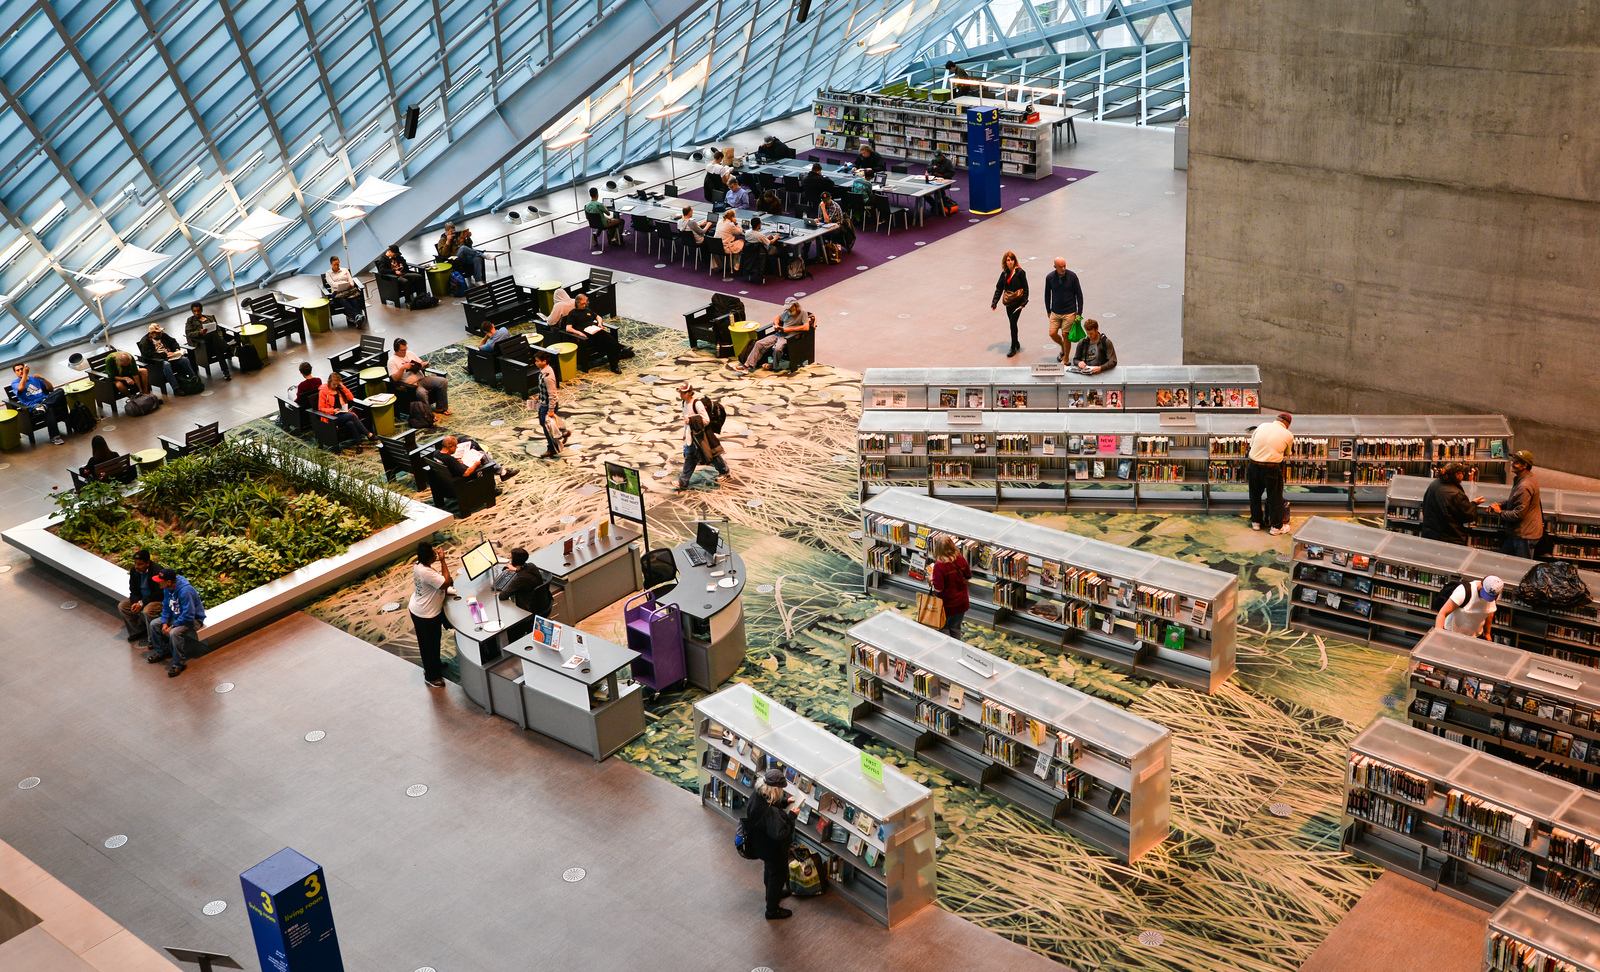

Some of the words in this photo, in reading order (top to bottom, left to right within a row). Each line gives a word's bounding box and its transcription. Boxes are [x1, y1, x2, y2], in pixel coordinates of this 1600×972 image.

[976, 112, 982, 122] 3
[992, 110, 998, 120] 3
[1342, 440, 1352, 458] YOU
[1537, 666, 1554, 674] movies
[865, 757, 877, 766] FIRST
[864, 764, 880, 775] NOVELS
[304, 874, 321, 898] 3
[260, 891, 274, 914] 3
[284, 907, 304, 922] living
[305, 896, 324, 910] room
